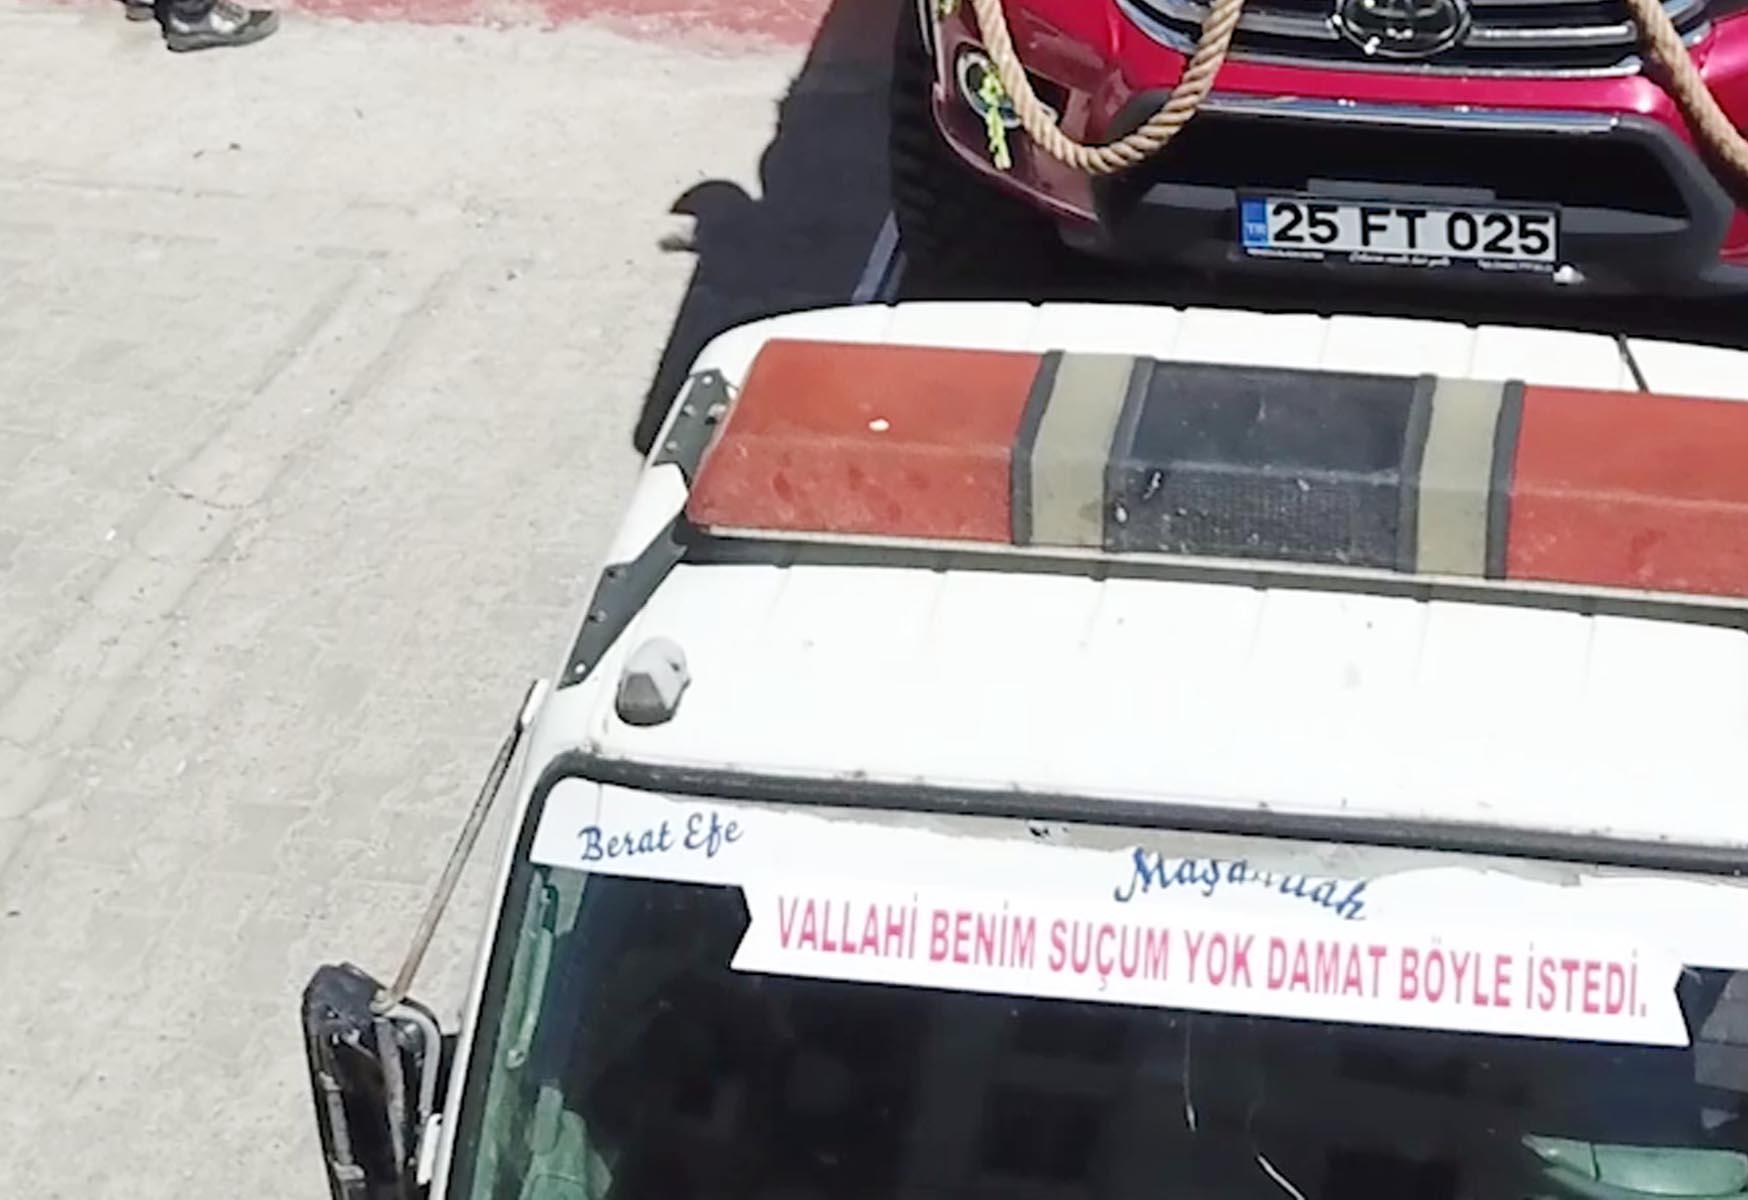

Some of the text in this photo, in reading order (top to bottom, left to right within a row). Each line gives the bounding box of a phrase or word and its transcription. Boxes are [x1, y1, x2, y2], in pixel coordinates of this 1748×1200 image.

[1271, 202, 1551, 256] 25 FT 025
[577, 811, 744, 861] Berat Efe
[778, 892, 1648, 1018] VALLAHİ BENİM SUÇUM YOK DAMAT BÖYLE İSTEDİ.
